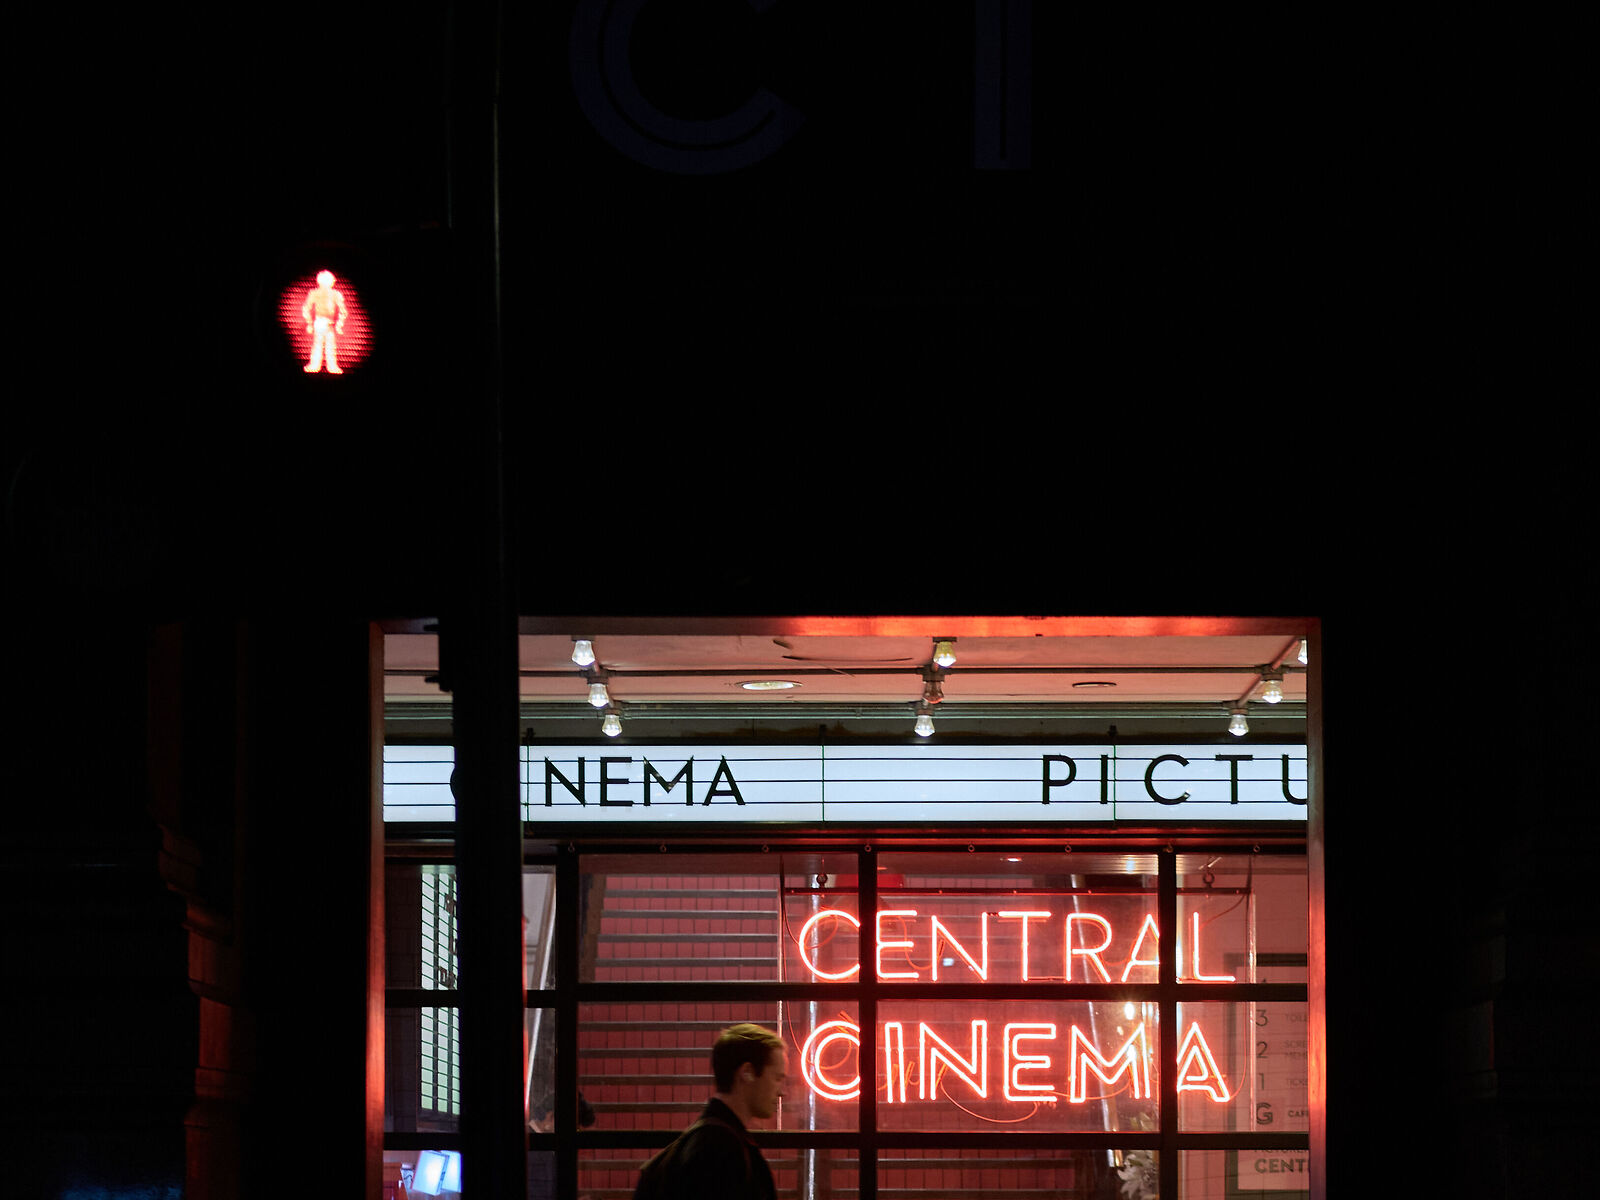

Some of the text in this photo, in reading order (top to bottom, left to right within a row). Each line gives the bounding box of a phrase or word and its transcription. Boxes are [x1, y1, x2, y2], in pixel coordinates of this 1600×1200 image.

[1042, 753, 1308, 805] PICTU
[798, 909, 1237, 982] CENTRAL
[1255, 1009, 1269, 1027] 3
[1256, 1041, 1269, 1059] 2
[800, 1018, 1231, 1104] CINEMA
[1258, 1072, 1265, 1091] 1
[1256, 1102, 1274, 1125] G
[1254, 1158, 1310, 1174] CENT
